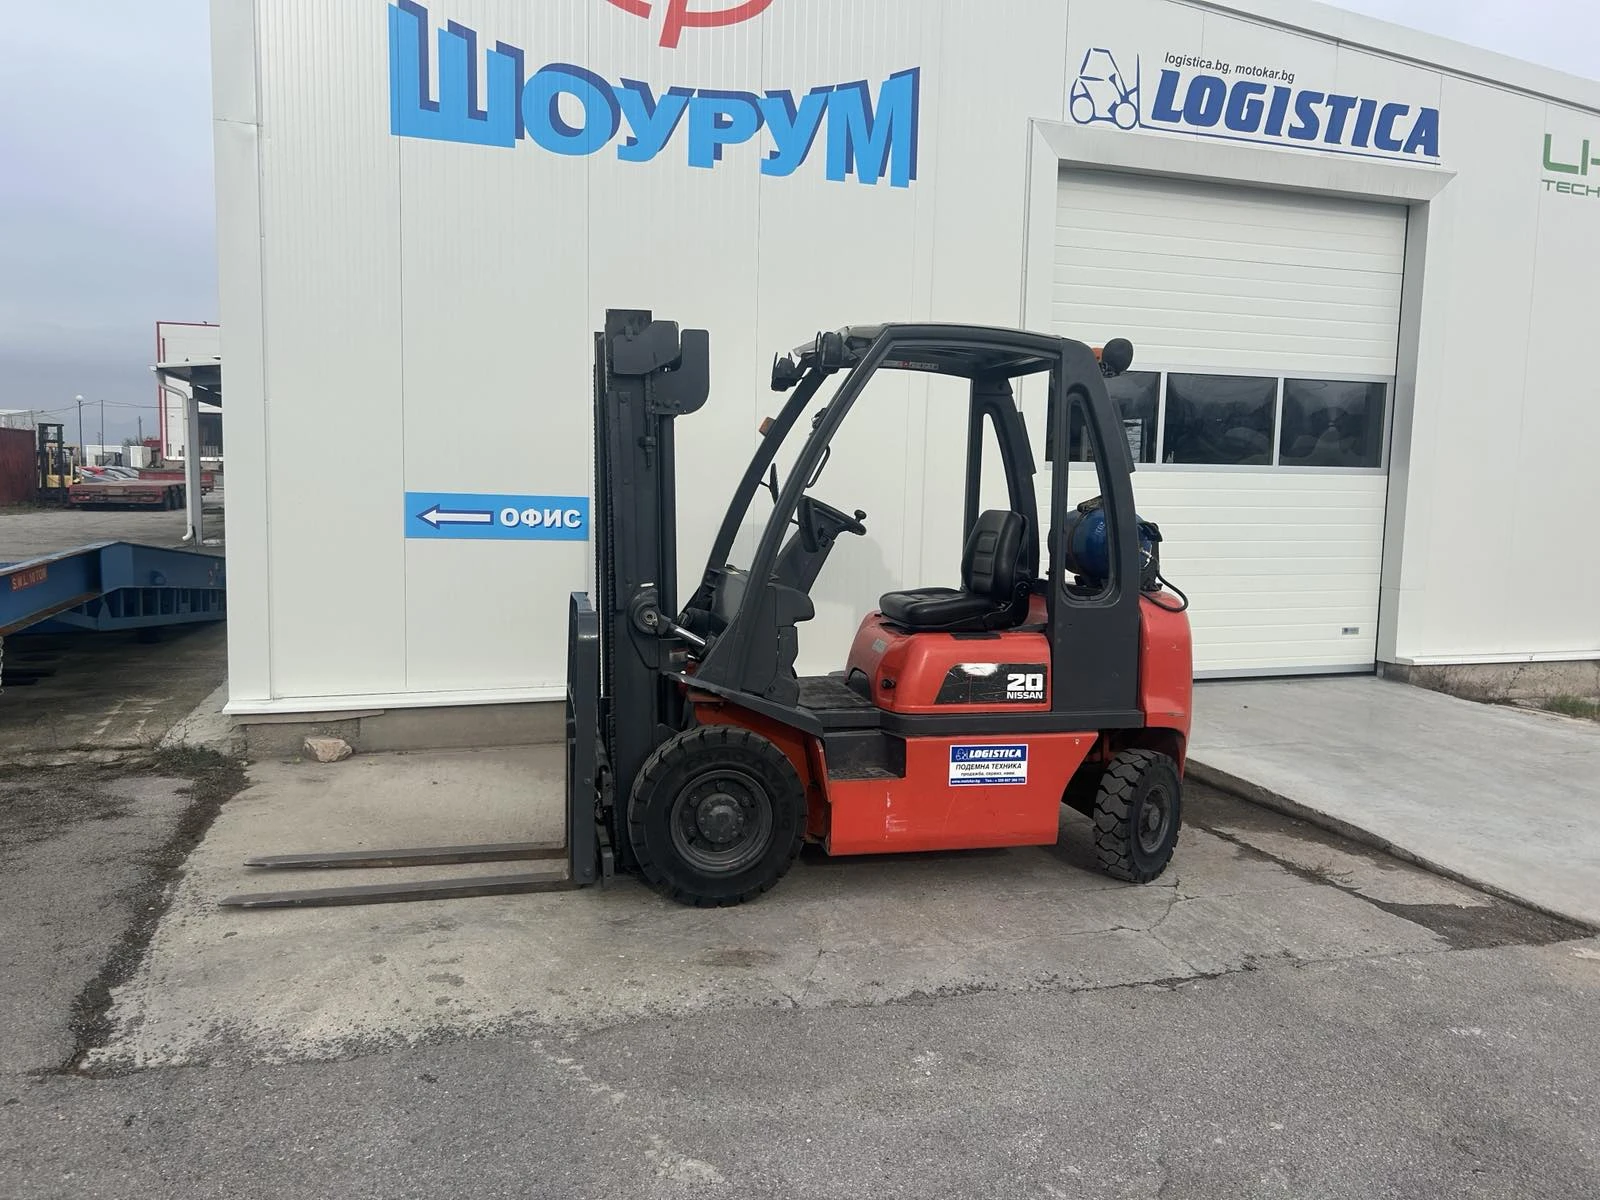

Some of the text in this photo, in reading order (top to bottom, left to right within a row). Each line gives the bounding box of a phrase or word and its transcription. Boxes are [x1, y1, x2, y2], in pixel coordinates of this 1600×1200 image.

[1164, 52, 1296, 84] logistica.bg, motokar.bg
[388, 0, 920, 188] ШОУРУМ
[1151, 69, 1440, 157] LOGISTICA
[500, 507, 582, 528] ОФИС
[1006, 673, 1044, 691] 20
[1006, 691, 1043, 699] NISSAN
[969, 749, 1022, 759] LOGISTICA
[956, 762, 1022, 771] ПОДЕМНА ТЕХНИКА
